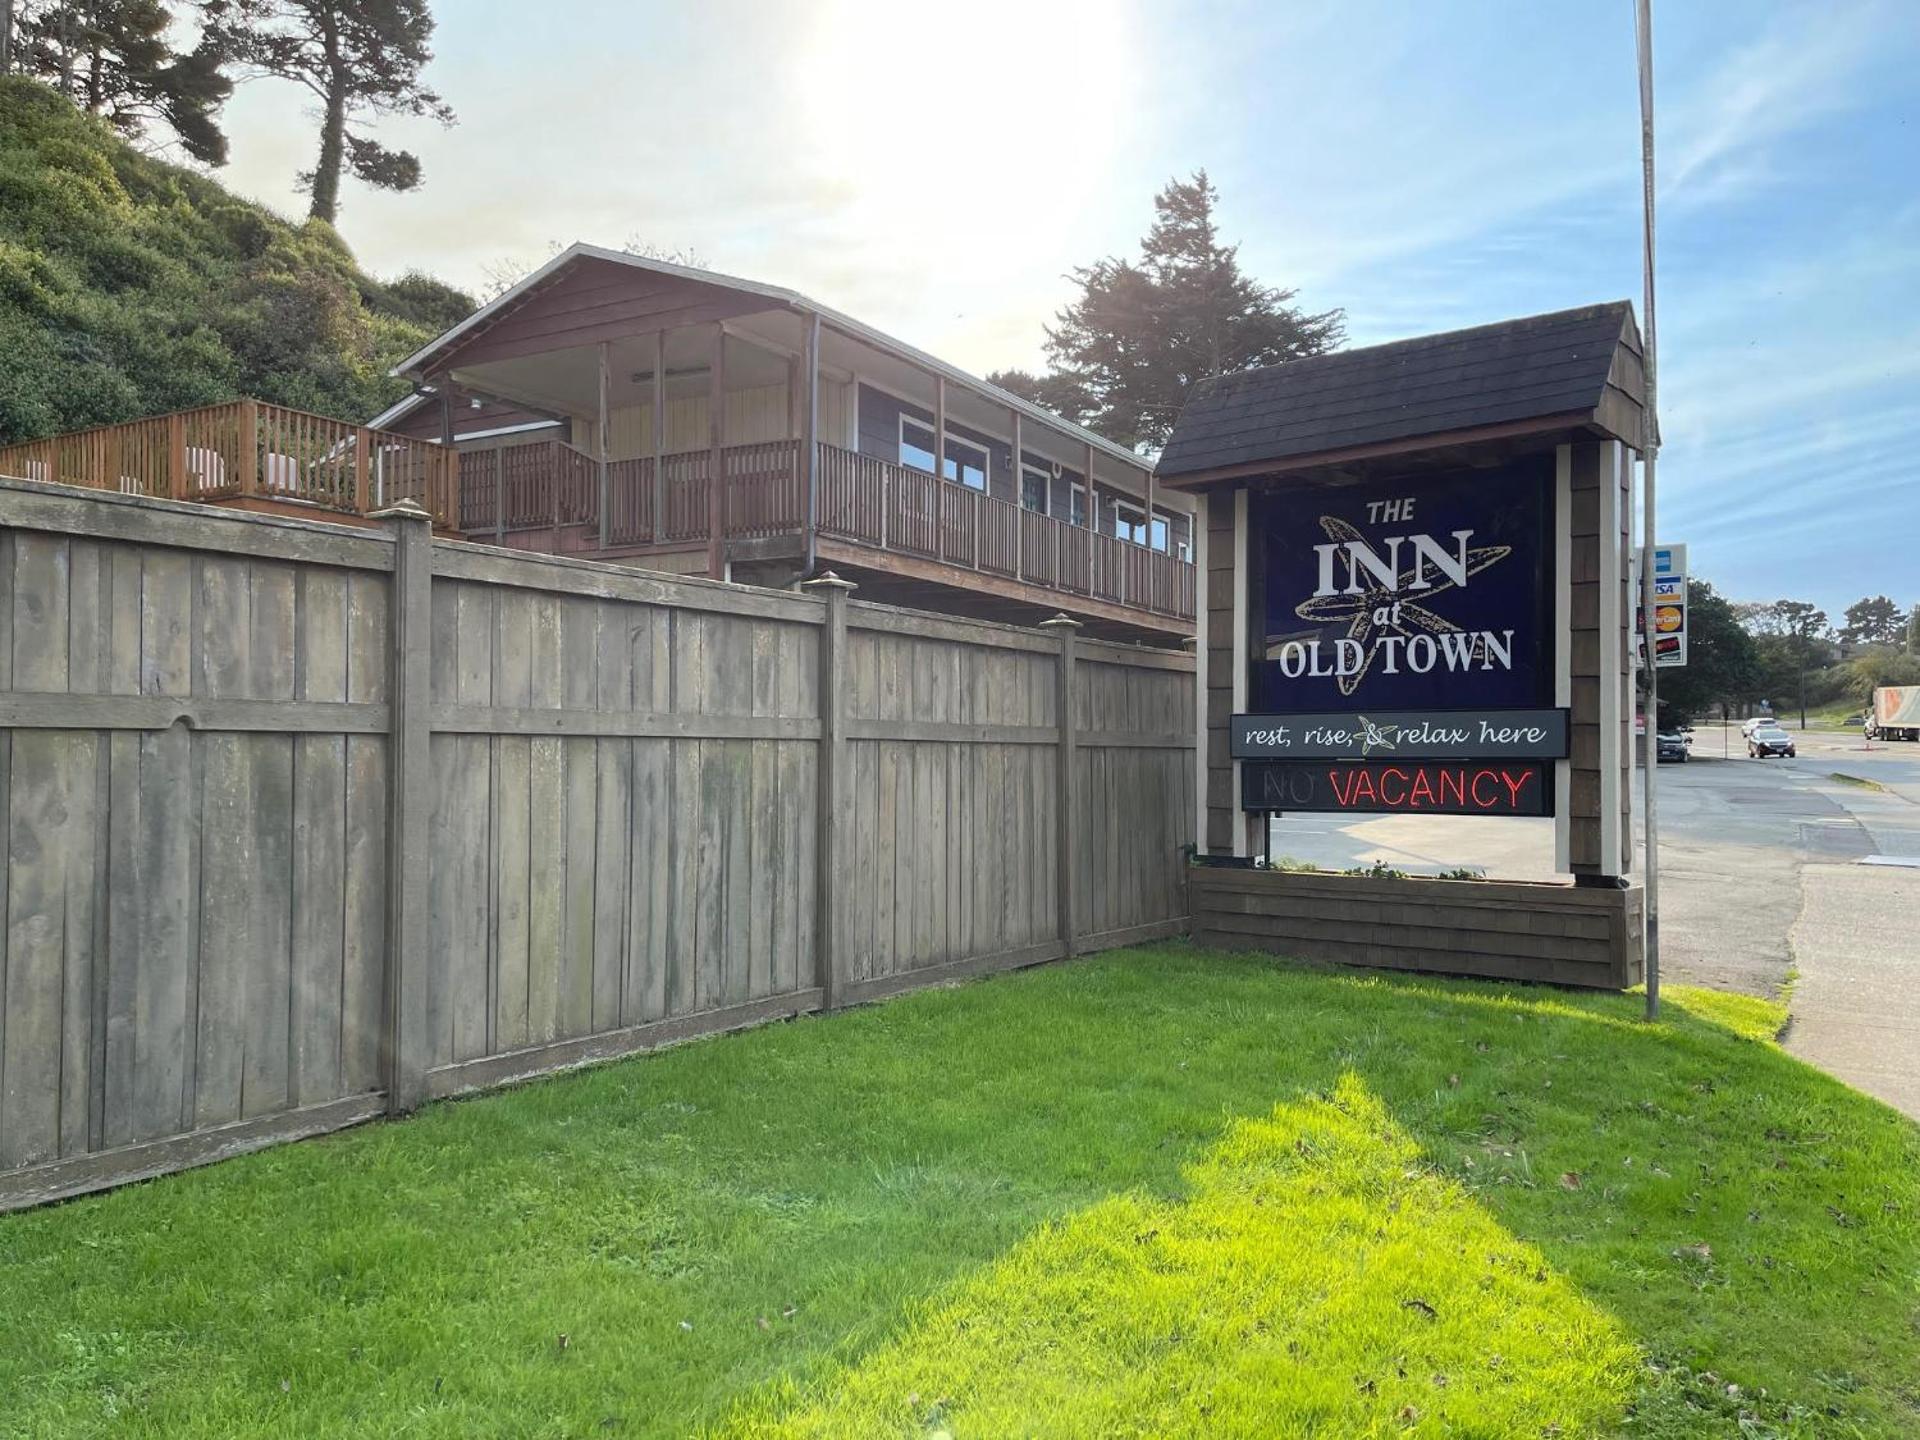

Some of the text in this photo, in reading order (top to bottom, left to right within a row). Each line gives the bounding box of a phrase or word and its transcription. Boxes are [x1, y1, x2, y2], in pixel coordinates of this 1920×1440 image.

[1366, 498, 1416, 524] THE
[1313, 529, 1474, 597] INN
[1655, 584, 1674, 594] ISA
[1373, 601, 1401, 626] at
[1279, 630, 1514, 678] OLD TOWN
[1245, 725, 1291, 747] rest,
[1303, 725, 1353, 747] rise,
[1396, 722, 1470, 745] relax
[1479, 721, 1548, 744] here
[1263, 768, 1533, 808] NO VACANCY
